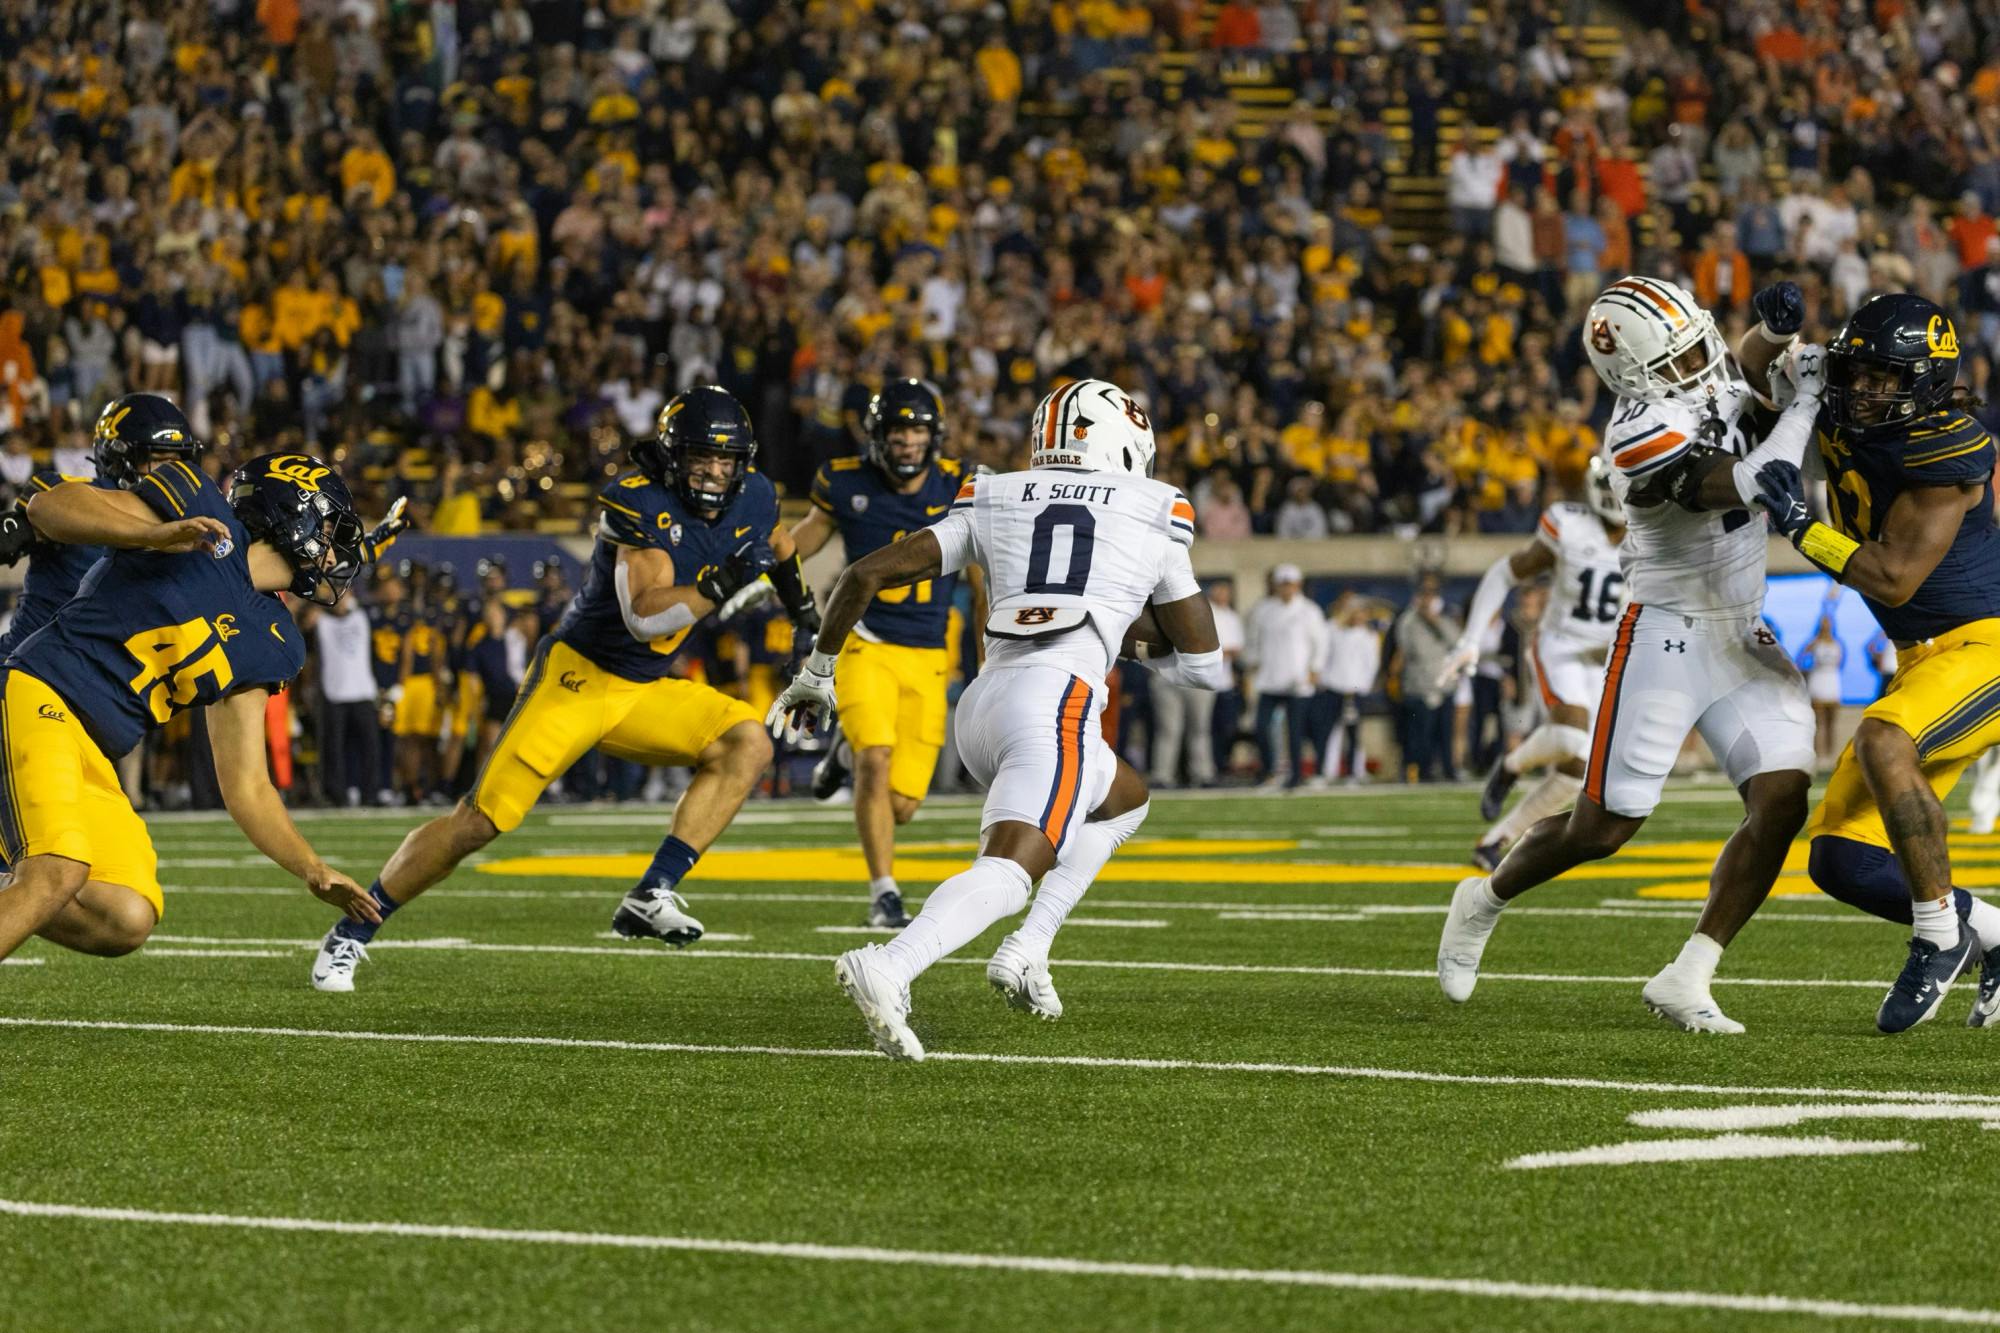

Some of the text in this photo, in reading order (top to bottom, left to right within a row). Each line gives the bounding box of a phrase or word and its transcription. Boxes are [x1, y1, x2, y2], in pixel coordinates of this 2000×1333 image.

[1927, 315, 1960, 359] Cal
[1613, 402, 1650, 427] 10
[264, 455, 331, 492] Cal
[1045, 455, 1082, 466] EAGLE
[1021, 482, 1117, 505] K. SCOTT
[1024, 504, 1096, 597] 0
[1571, 567, 1624, 623] 16
[212, 613, 240, 642] Cal
[124, 616, 234, 724] 45
[559, 670, 587, 693] Cal
[38, 704, 66, 722] Cal
